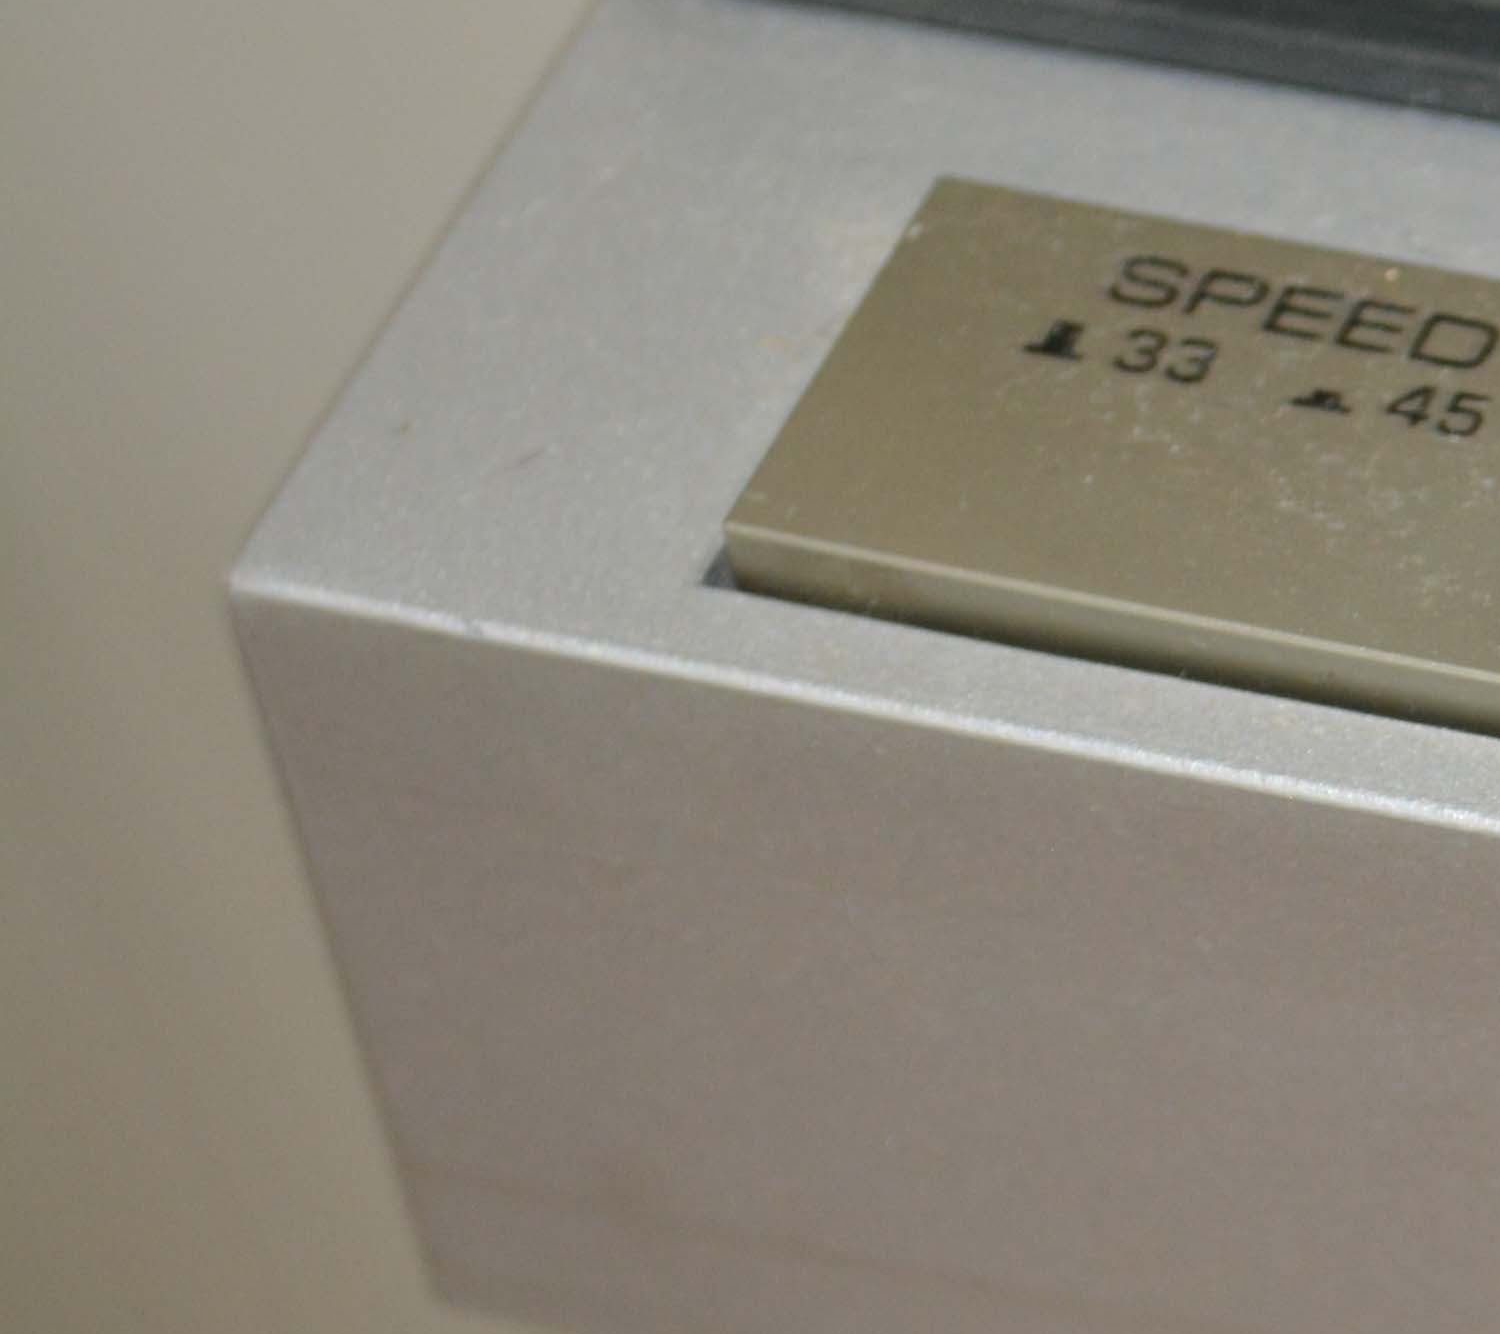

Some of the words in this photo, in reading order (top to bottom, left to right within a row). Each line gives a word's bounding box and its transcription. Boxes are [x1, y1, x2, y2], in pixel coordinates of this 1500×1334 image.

[1108, 255, 1500, 369] SPEED
[1112, 327, 1220, 384] 33
[1384, 385, 1492, 437] 45
